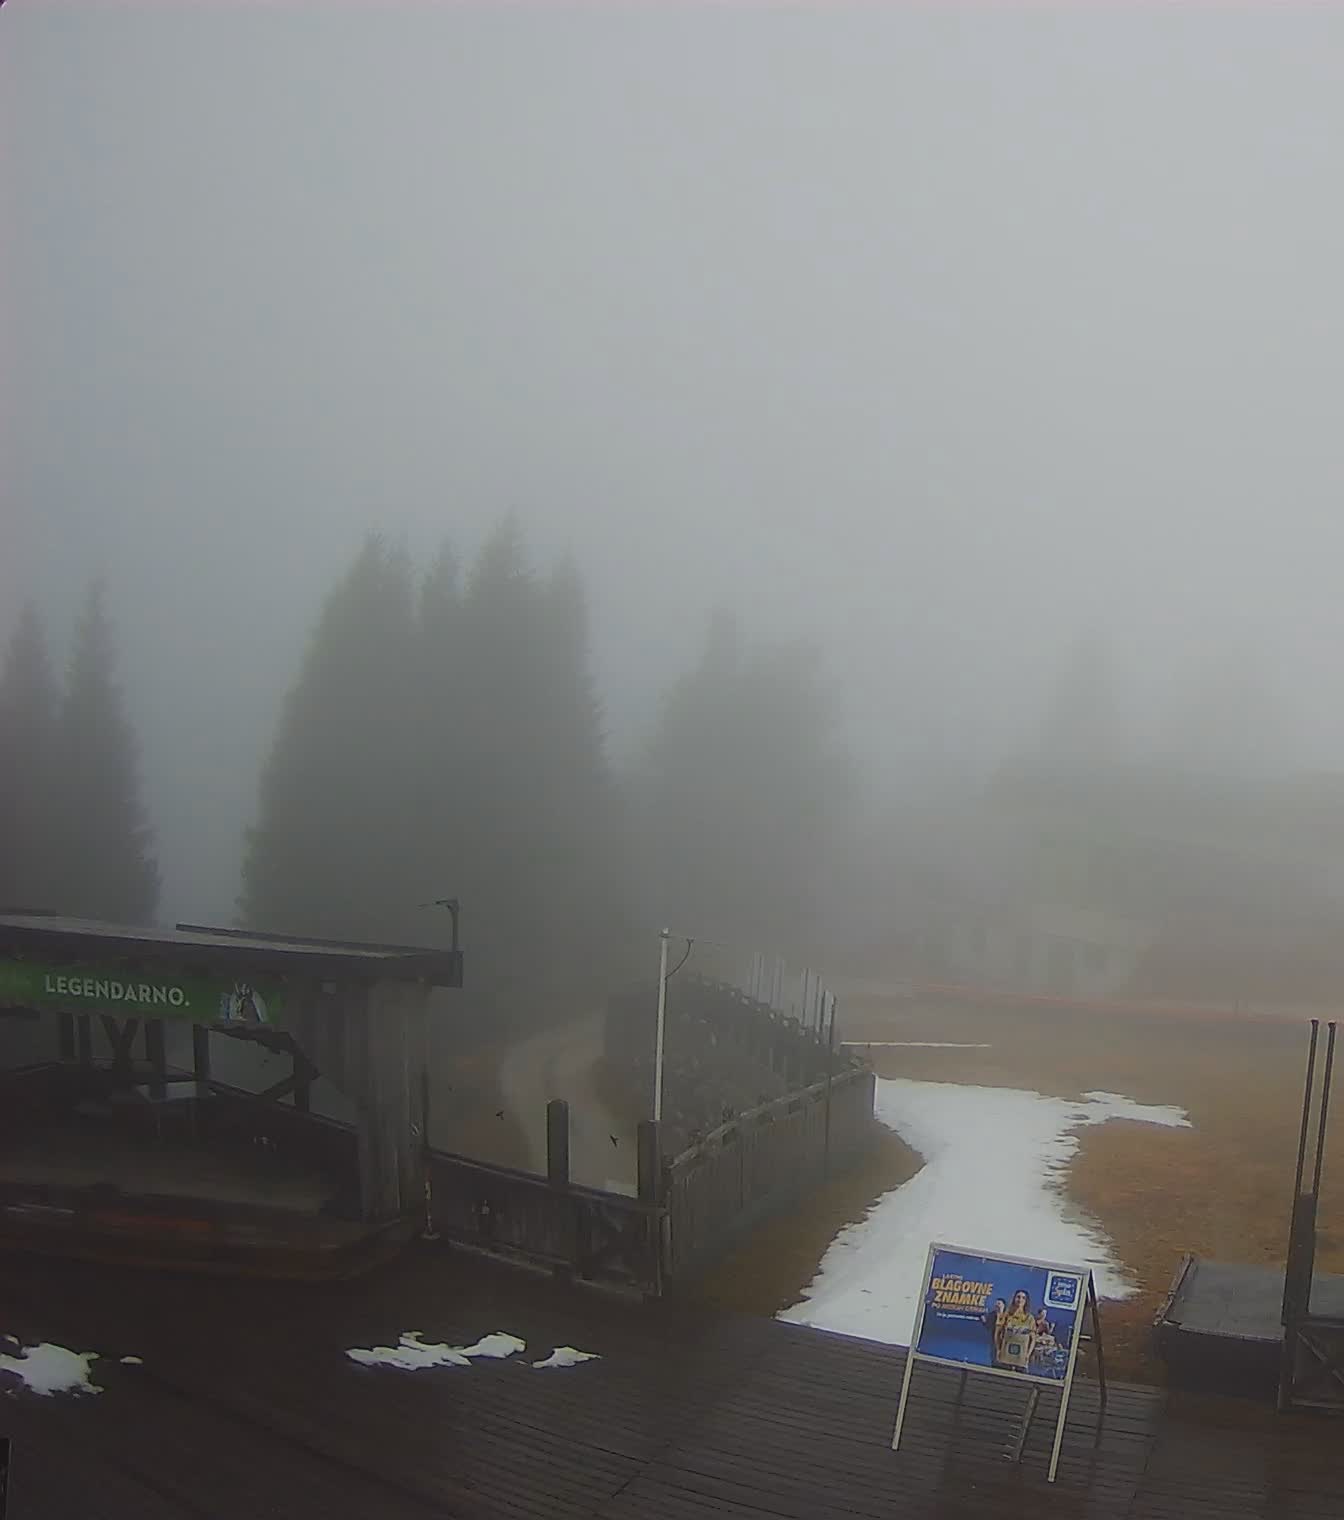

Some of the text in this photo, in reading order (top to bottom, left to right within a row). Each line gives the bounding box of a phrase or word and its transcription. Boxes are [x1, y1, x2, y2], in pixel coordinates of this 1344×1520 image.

[44, 974, 191, 1007] LEGENDARNO.
[931, 1277, 994, 1296] BLAGOVNE
[934, 1290, 987, 1307] ZNAMKE
